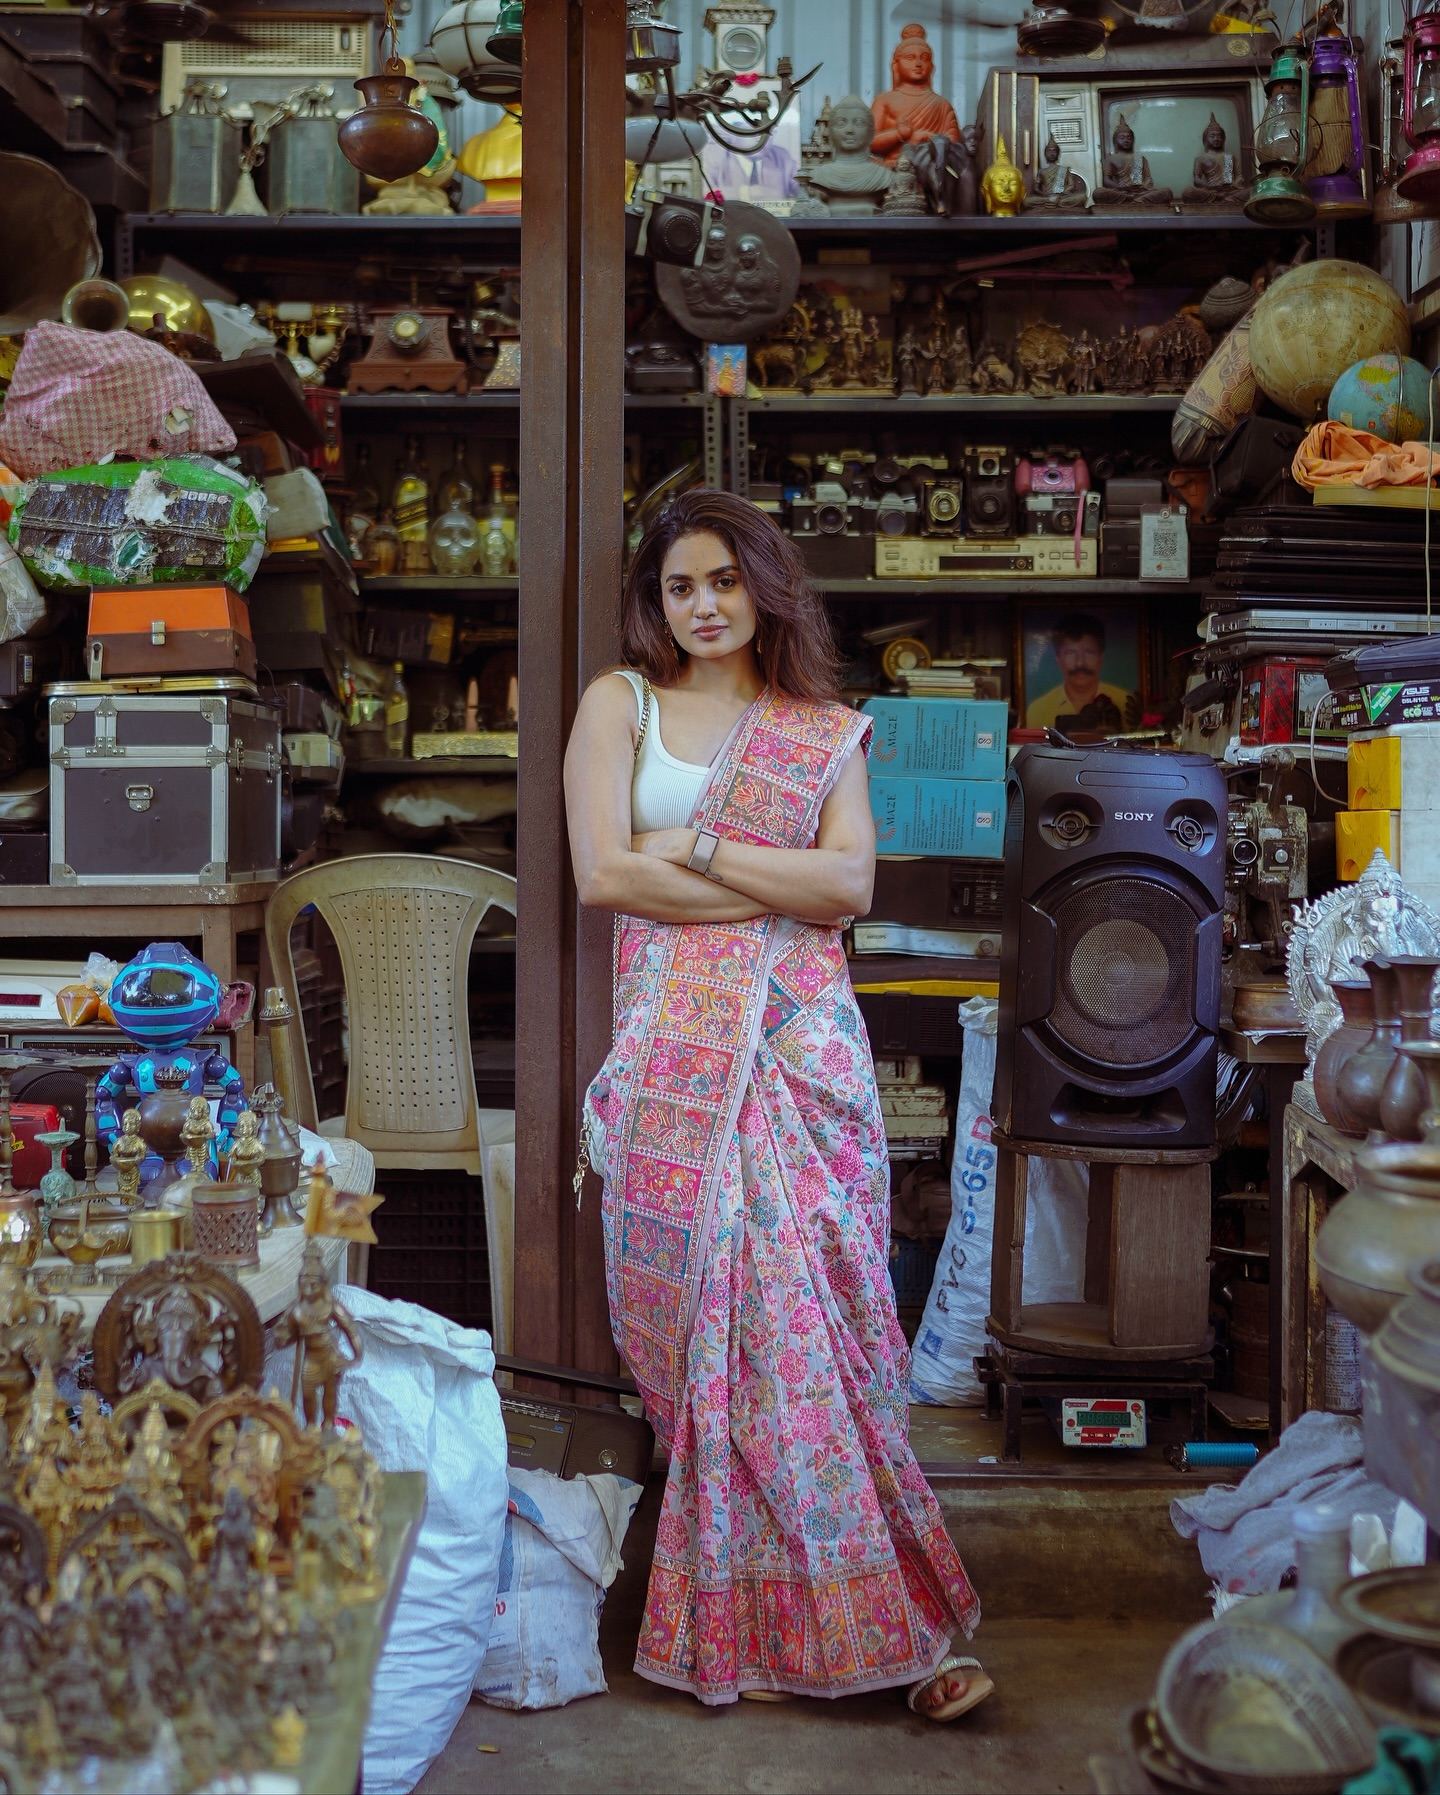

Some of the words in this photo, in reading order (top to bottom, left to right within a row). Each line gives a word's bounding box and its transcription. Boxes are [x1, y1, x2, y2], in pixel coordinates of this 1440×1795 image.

[1402, 687, 1430, 695] ASUS
[1114, 811, 1154, 822] SONY
[936, 1243, 968, 1313] PVC
